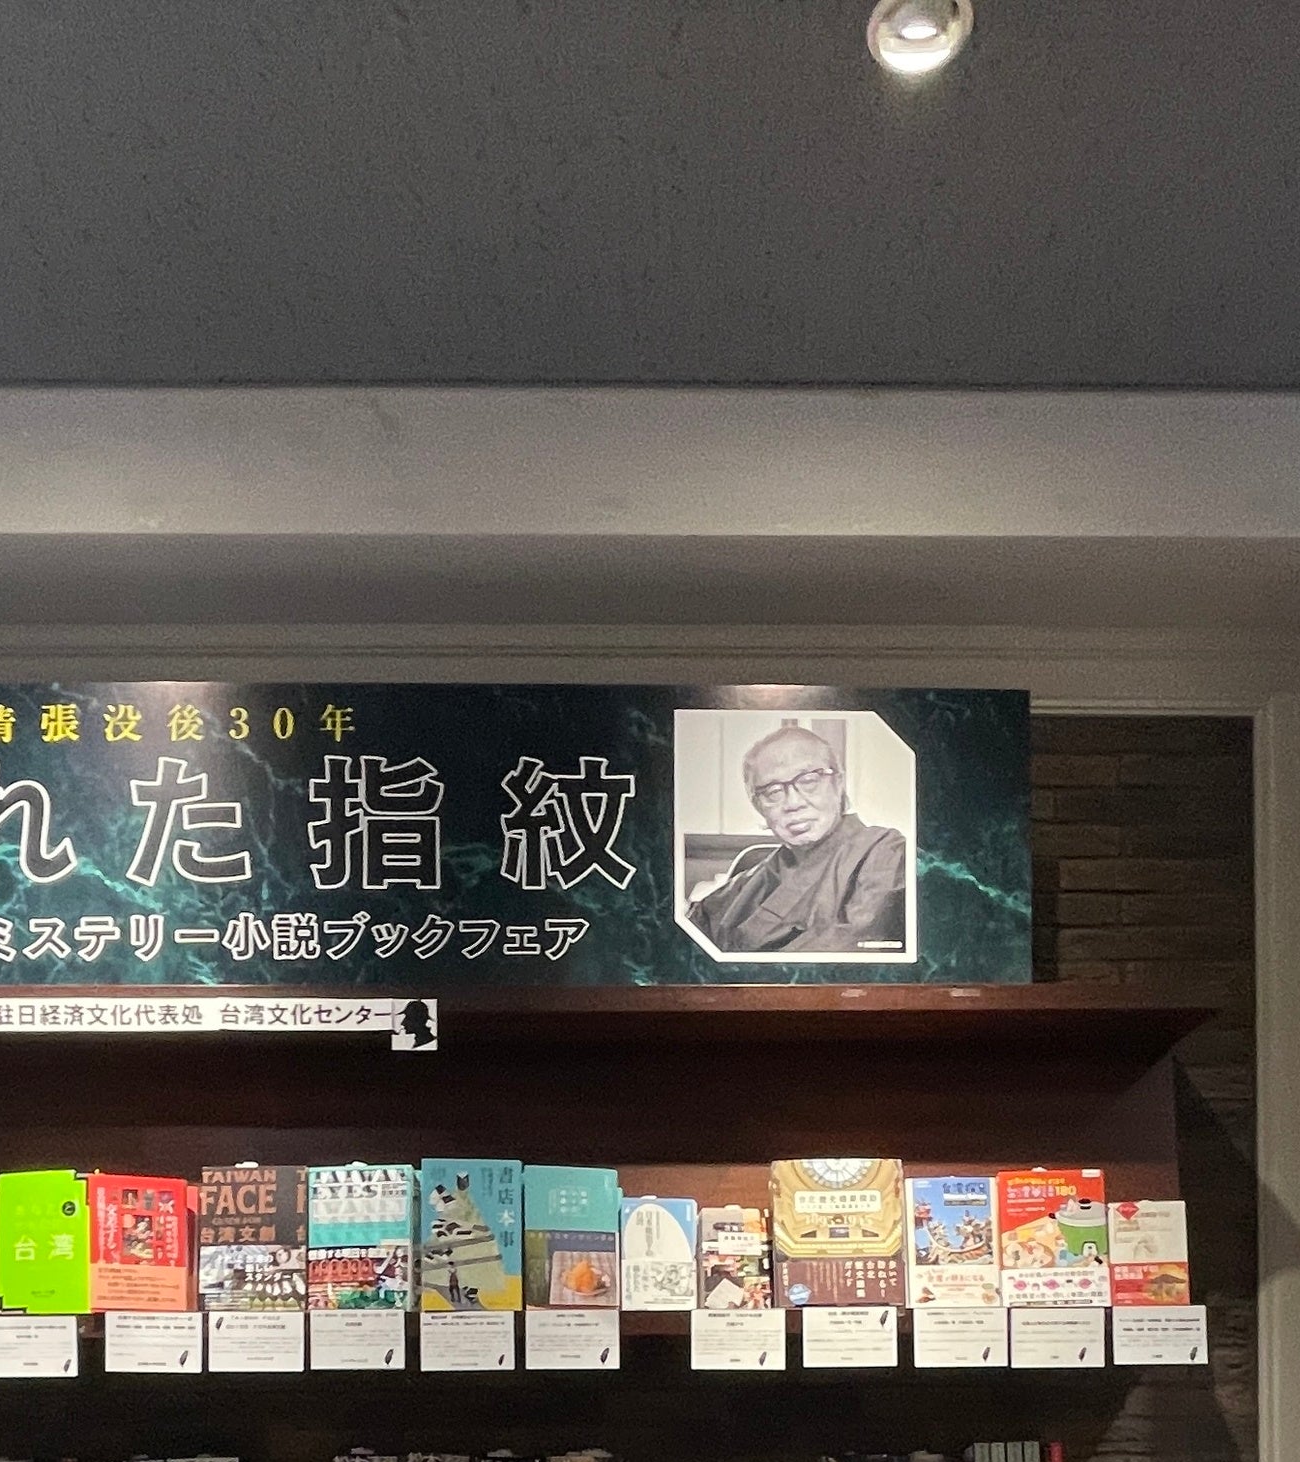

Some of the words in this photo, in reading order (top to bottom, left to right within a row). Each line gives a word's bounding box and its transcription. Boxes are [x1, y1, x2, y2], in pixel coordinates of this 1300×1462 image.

[219, 1003, 391, 1028] 台湾文化センター
[202, 1169, 277, 1184] TAIWAN
[313, 1169, 407, 1184] TAIWAN
[199, 1184, 277, 1215] FACE
[311, 1184, 378, 1200] EYES
[14, 1233, 76, 1262] 台湾
